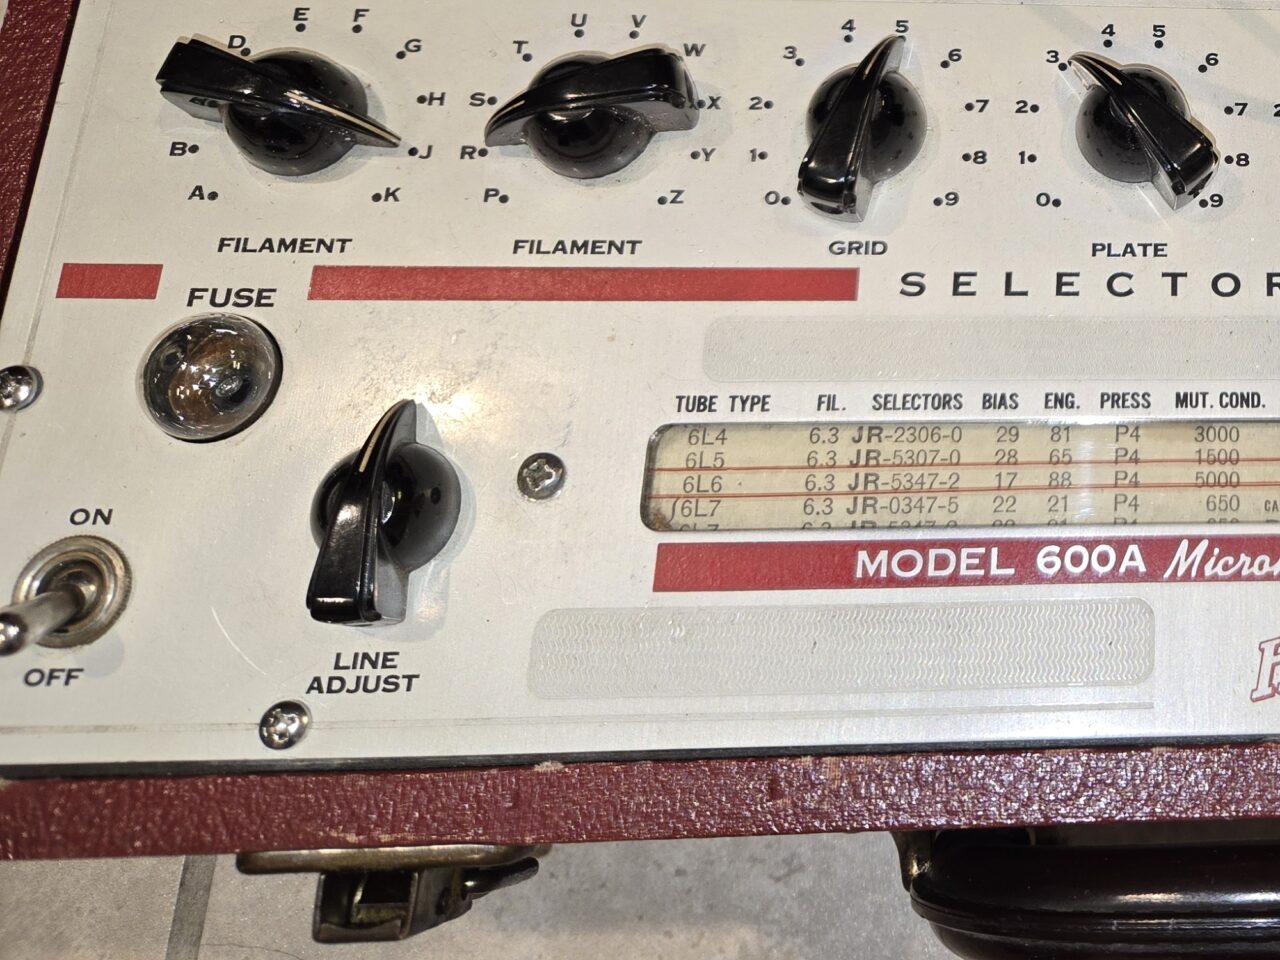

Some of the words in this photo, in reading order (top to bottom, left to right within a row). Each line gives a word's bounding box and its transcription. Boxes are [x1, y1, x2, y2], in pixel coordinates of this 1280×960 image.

[217, 237, 353, 253] FILAMENT
[512, 239, 643, 255] FILAMENT
[828, 240, 888, 256] GRID
[1091, 243, 1168, 258] PLATE
[186, 288, 277, 308] FUSE
[675, 395, 717, 413] TUBE
[729, 395, 771, 412] TYPE
[817, 394, 846, 411] FIL.
[872, 393, 963, 411] SELECTORS
[982, 393, 1019, 410] BIAS
[1044, 392, 1080, 410] ENG.
[1100, 392, 1151, 409] PRESS
[1175, 392, 1214, 409] MUT.
[1219, 392, 1266, 408] COND.
[687, 428, 728, 446] 6L4
[809, 427, 839, 444] 6.3
[851, 426, 963, 444] JR-2306-0
[996, 426, 1020, 443] 29
[1050, 426, 1071, 443] 81
[1115, 426, 1141, 442] P4
[1194, 426, 1240, 442] 3000
[680, 499, 722, 518] 6L7
[803, 497, 833, 515] 6.3
[846, 497, 959, 515] JR-0347-5
[992, 497, 1017, 513] 22
[1047, 496, 1069, 513] 21
[1114, 495, 1140, 512] P4
[1206, 495, 1240, 512] 650
[69, 508, 113, 526] ON
[855, 547, 1015, 579] MODEL
[1035, 544, 1147, 575] 600A
[333, 651, 400, 671] LINE
[23, 668, 83, 687] OFF
[305, 674, 419, 694] ADJUST
